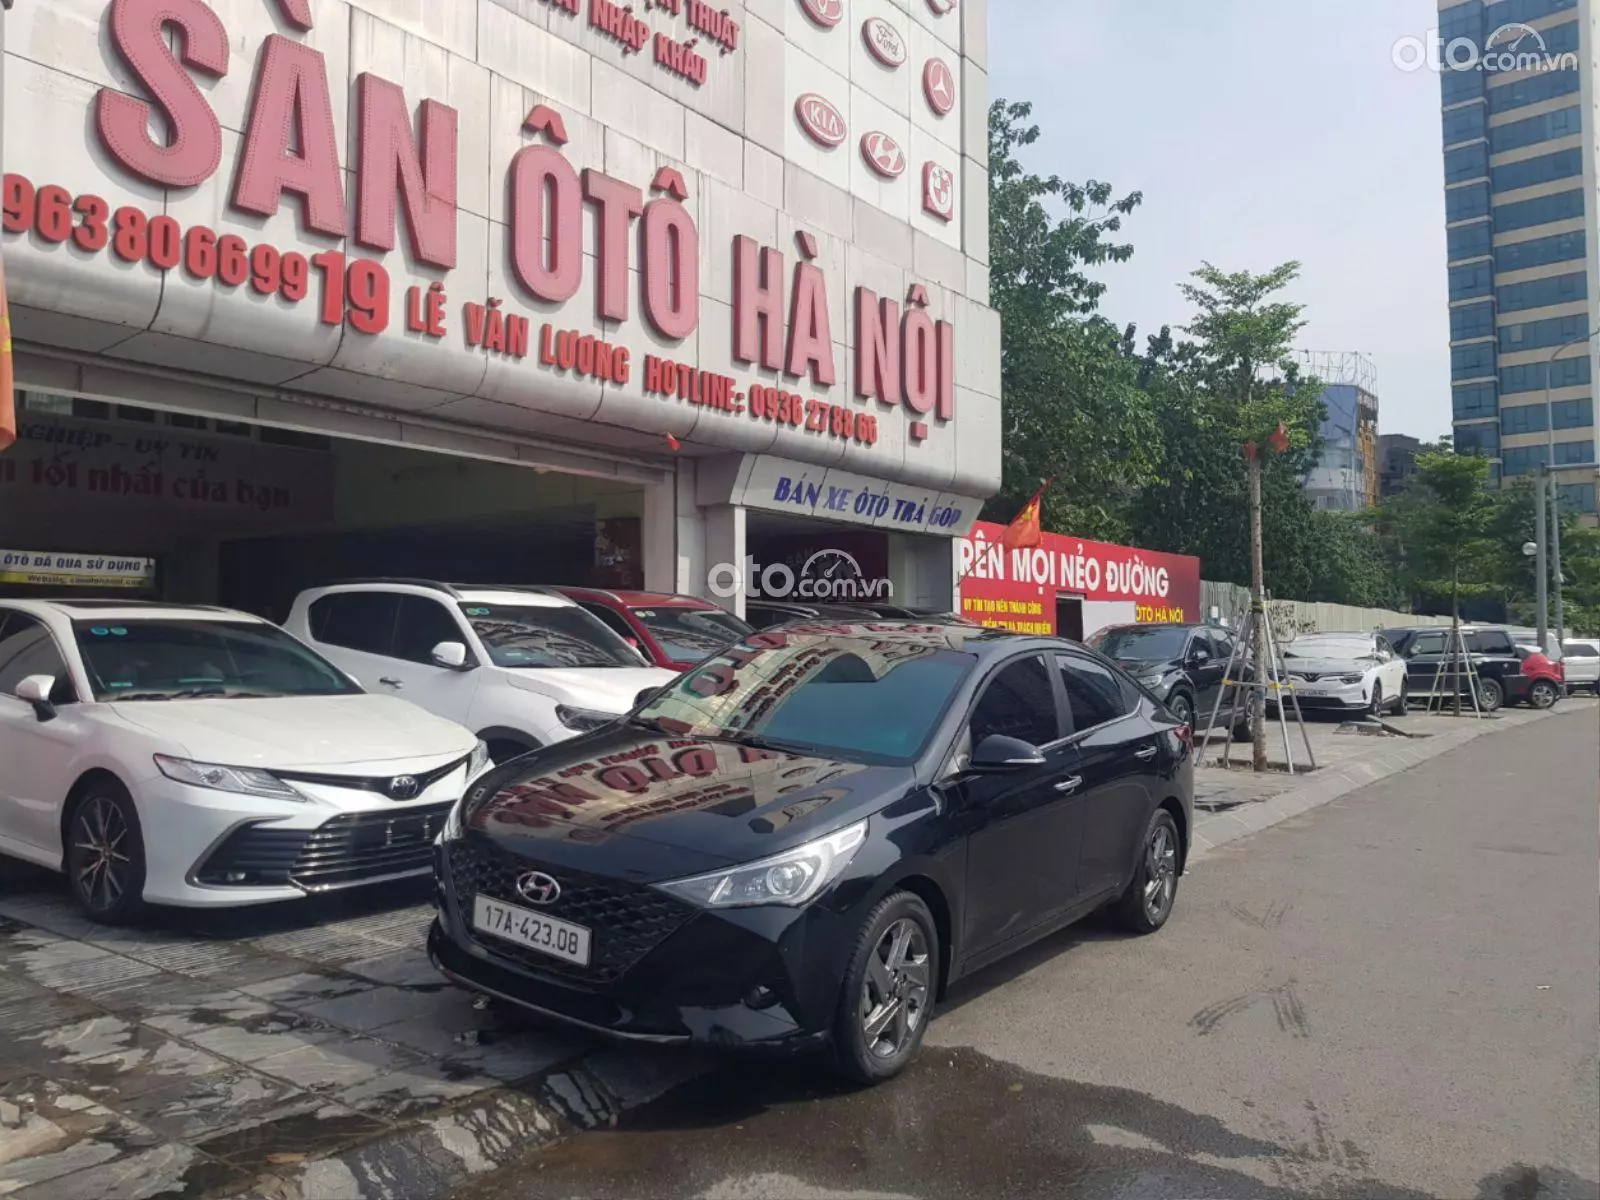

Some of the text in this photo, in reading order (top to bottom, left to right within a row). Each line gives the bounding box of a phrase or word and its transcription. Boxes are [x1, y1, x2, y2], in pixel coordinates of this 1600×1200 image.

[810, 103, 839, 135] KIA
[509, 104, 699, 339] ÔTÔ
[733, 230, 835, 386] HÀ
[855, 283, 953, 441] NỘI
[464, 296, 529, 357] VĂN
[541, 323, 630, 384] LƯƠNG
[644, 354, 745, 412] HOTLINE:
[773, 472, 822, 508] BÁN
[823, 486, 853, 512] XE
[854, 486, 889, 518] ÔTÔ
[928, 500, 962, 527] GÓP
[1012, 548, 1055, 594] MỌI
[1061, 543, 1100, 591] NẺO
[1106, 555, 1169, 598] ĐƯỜNG
[485, 905, 579, 955] 17A-423.08
